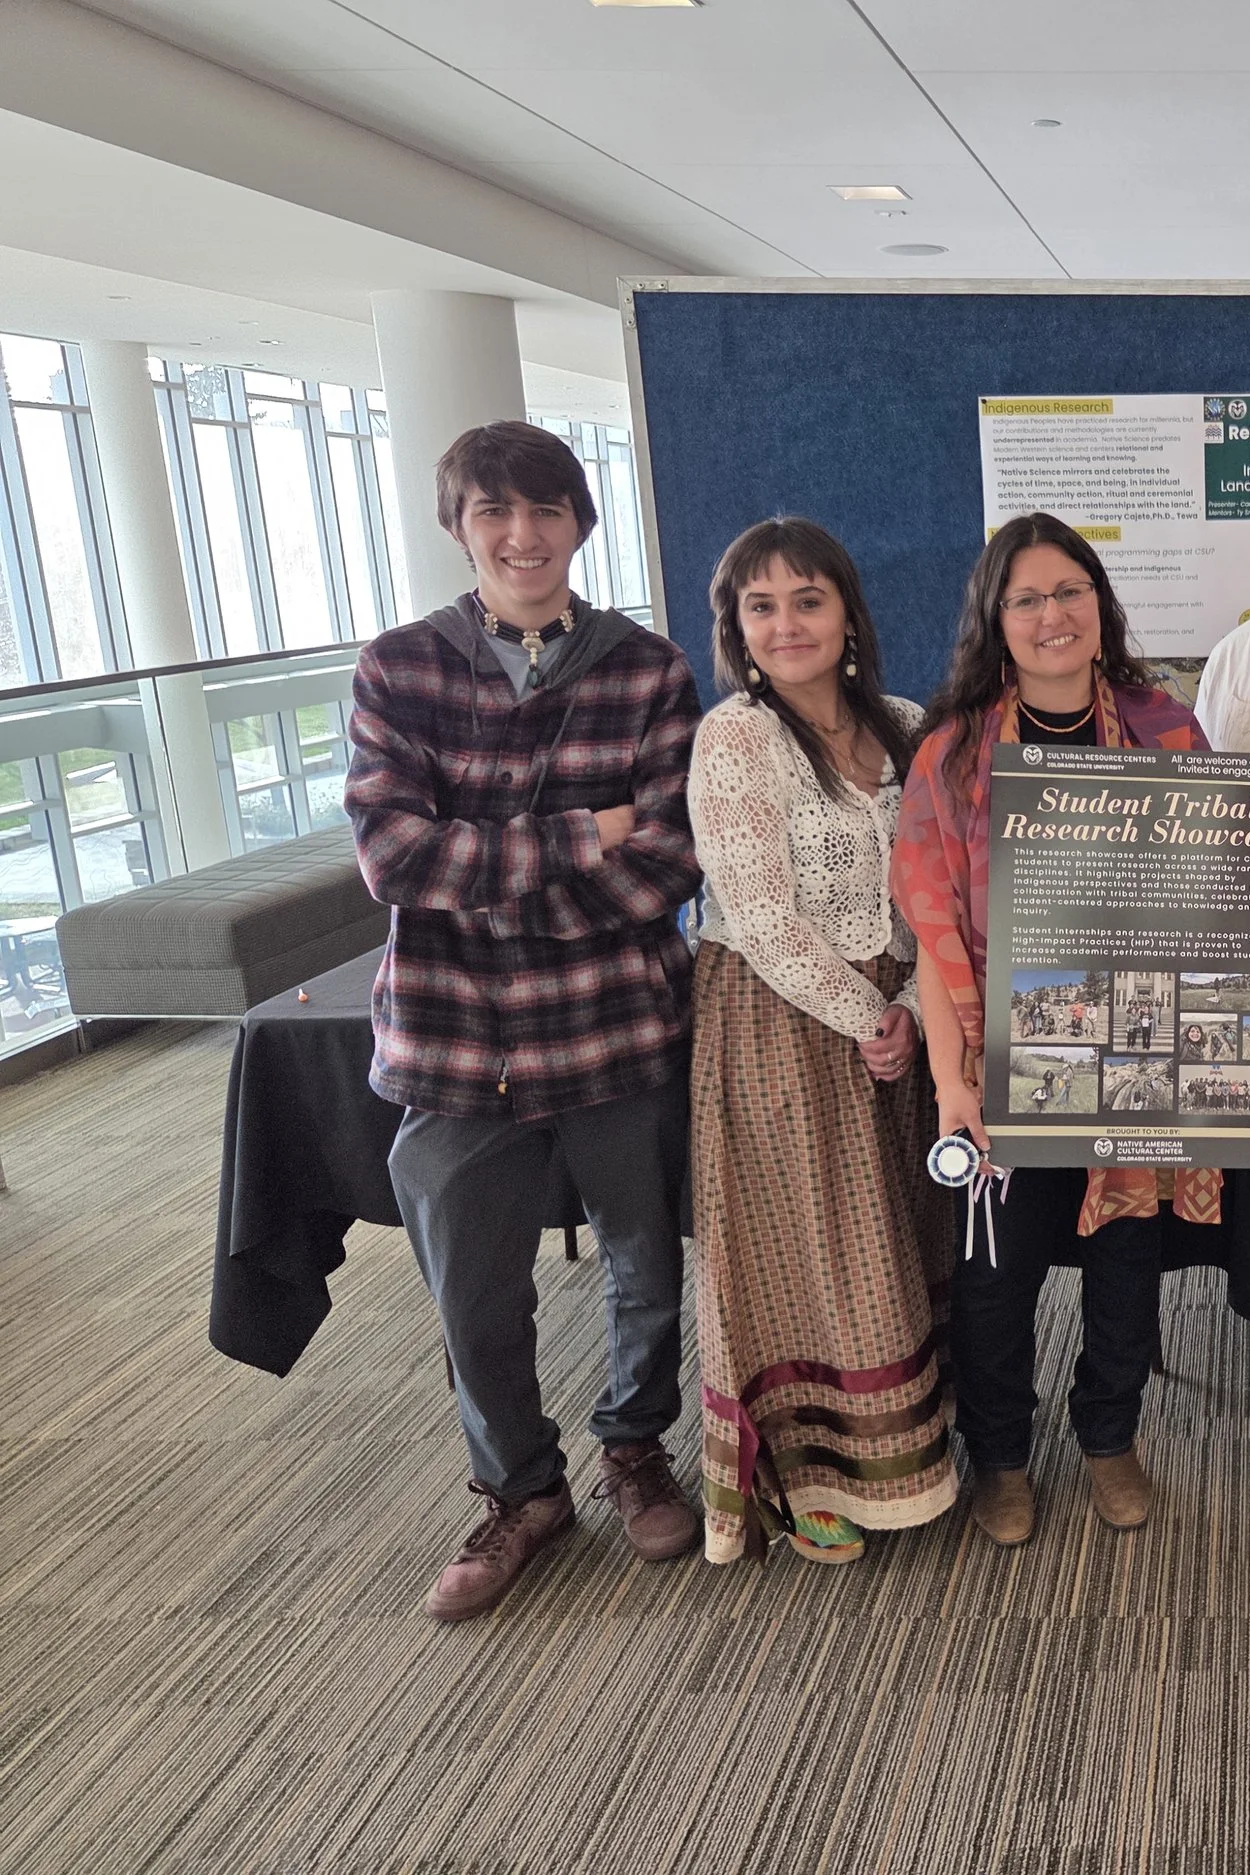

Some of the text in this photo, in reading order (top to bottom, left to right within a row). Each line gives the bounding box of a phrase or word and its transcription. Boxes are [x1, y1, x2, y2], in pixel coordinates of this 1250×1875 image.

[984, 402, 1109, 415] Indigenous Research
[1062, 467, 1092, 475] mirrors
[1111, 467, 1155, 475] celebrates
[997, 480, 1023, 489] cycles
[1025, 479, 1033, 487] of
[1034, 479, 1055, 488] time,
[1057, 480, 1084, 488] space,
[1103, 478, 1128, 488] being,
[1129, 478, 1137, 486] in
[1139, 478, 1180, 486] individual
[997, 491, 1026, 499] action,
[1027, 490, 1075, 500] community
[1076, 490, 1104, 498] action,
[1147, 489, 1193, 497] ceremonial
[1047, 752, 1156, 763] CULTURAL RESOURCE CENTERS
[1171, 755, 1182, 763] All
[1186, 756, 1202, 764] are
[1204, 756, 1247, 766] welcome
[1178, 764, 1209, 774] invited
[1211, 766, 1221, 774] to
[1037, 787, 1152, 815] Student
[1001, 814, 1138, 842] Research
[1013, 926, 1051, 934] Student
[1055, 927, 1111, 937] internships
[1115, 929, 1134, 939] and
[1138, 930, 1181, 940] research
[1012, 937, 1075, 945] High-Impact
[1080, 938, 1126, 946] Practices
[1130, 938, 1154, 948] (HIP)
